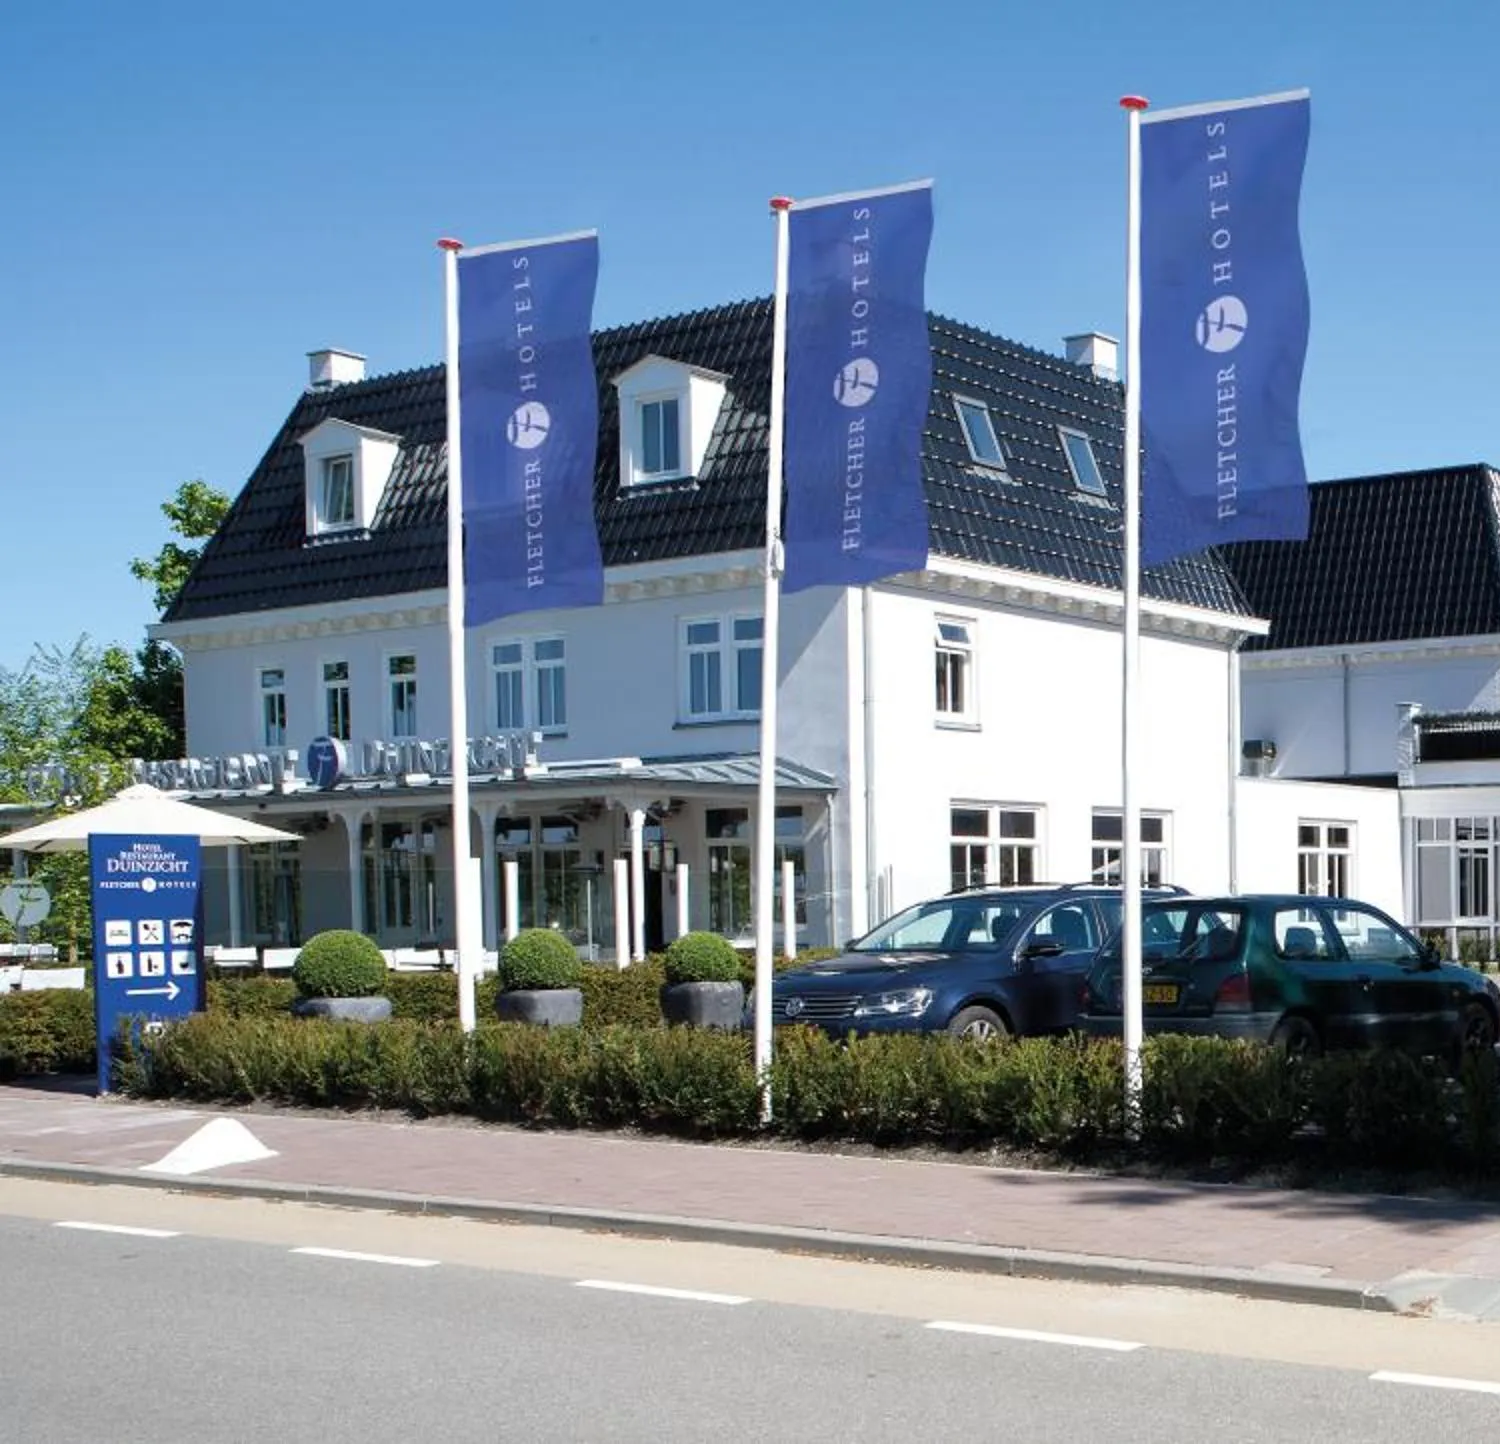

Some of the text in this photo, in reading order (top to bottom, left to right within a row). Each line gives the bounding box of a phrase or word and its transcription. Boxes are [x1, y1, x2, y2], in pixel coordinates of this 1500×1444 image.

[842, 206, 871, 552] FLETCHER HOTELS
[1206, 121, 1239, 520] FLETCHER HOTELS
[513, 255, 544, 589] FLETCHER HOTELS
[107, 858, 189, 873] DUINZICHT
[120, 851, 177, 861] RESTAURANT
[133, 843, 162, 852] HOTEL
